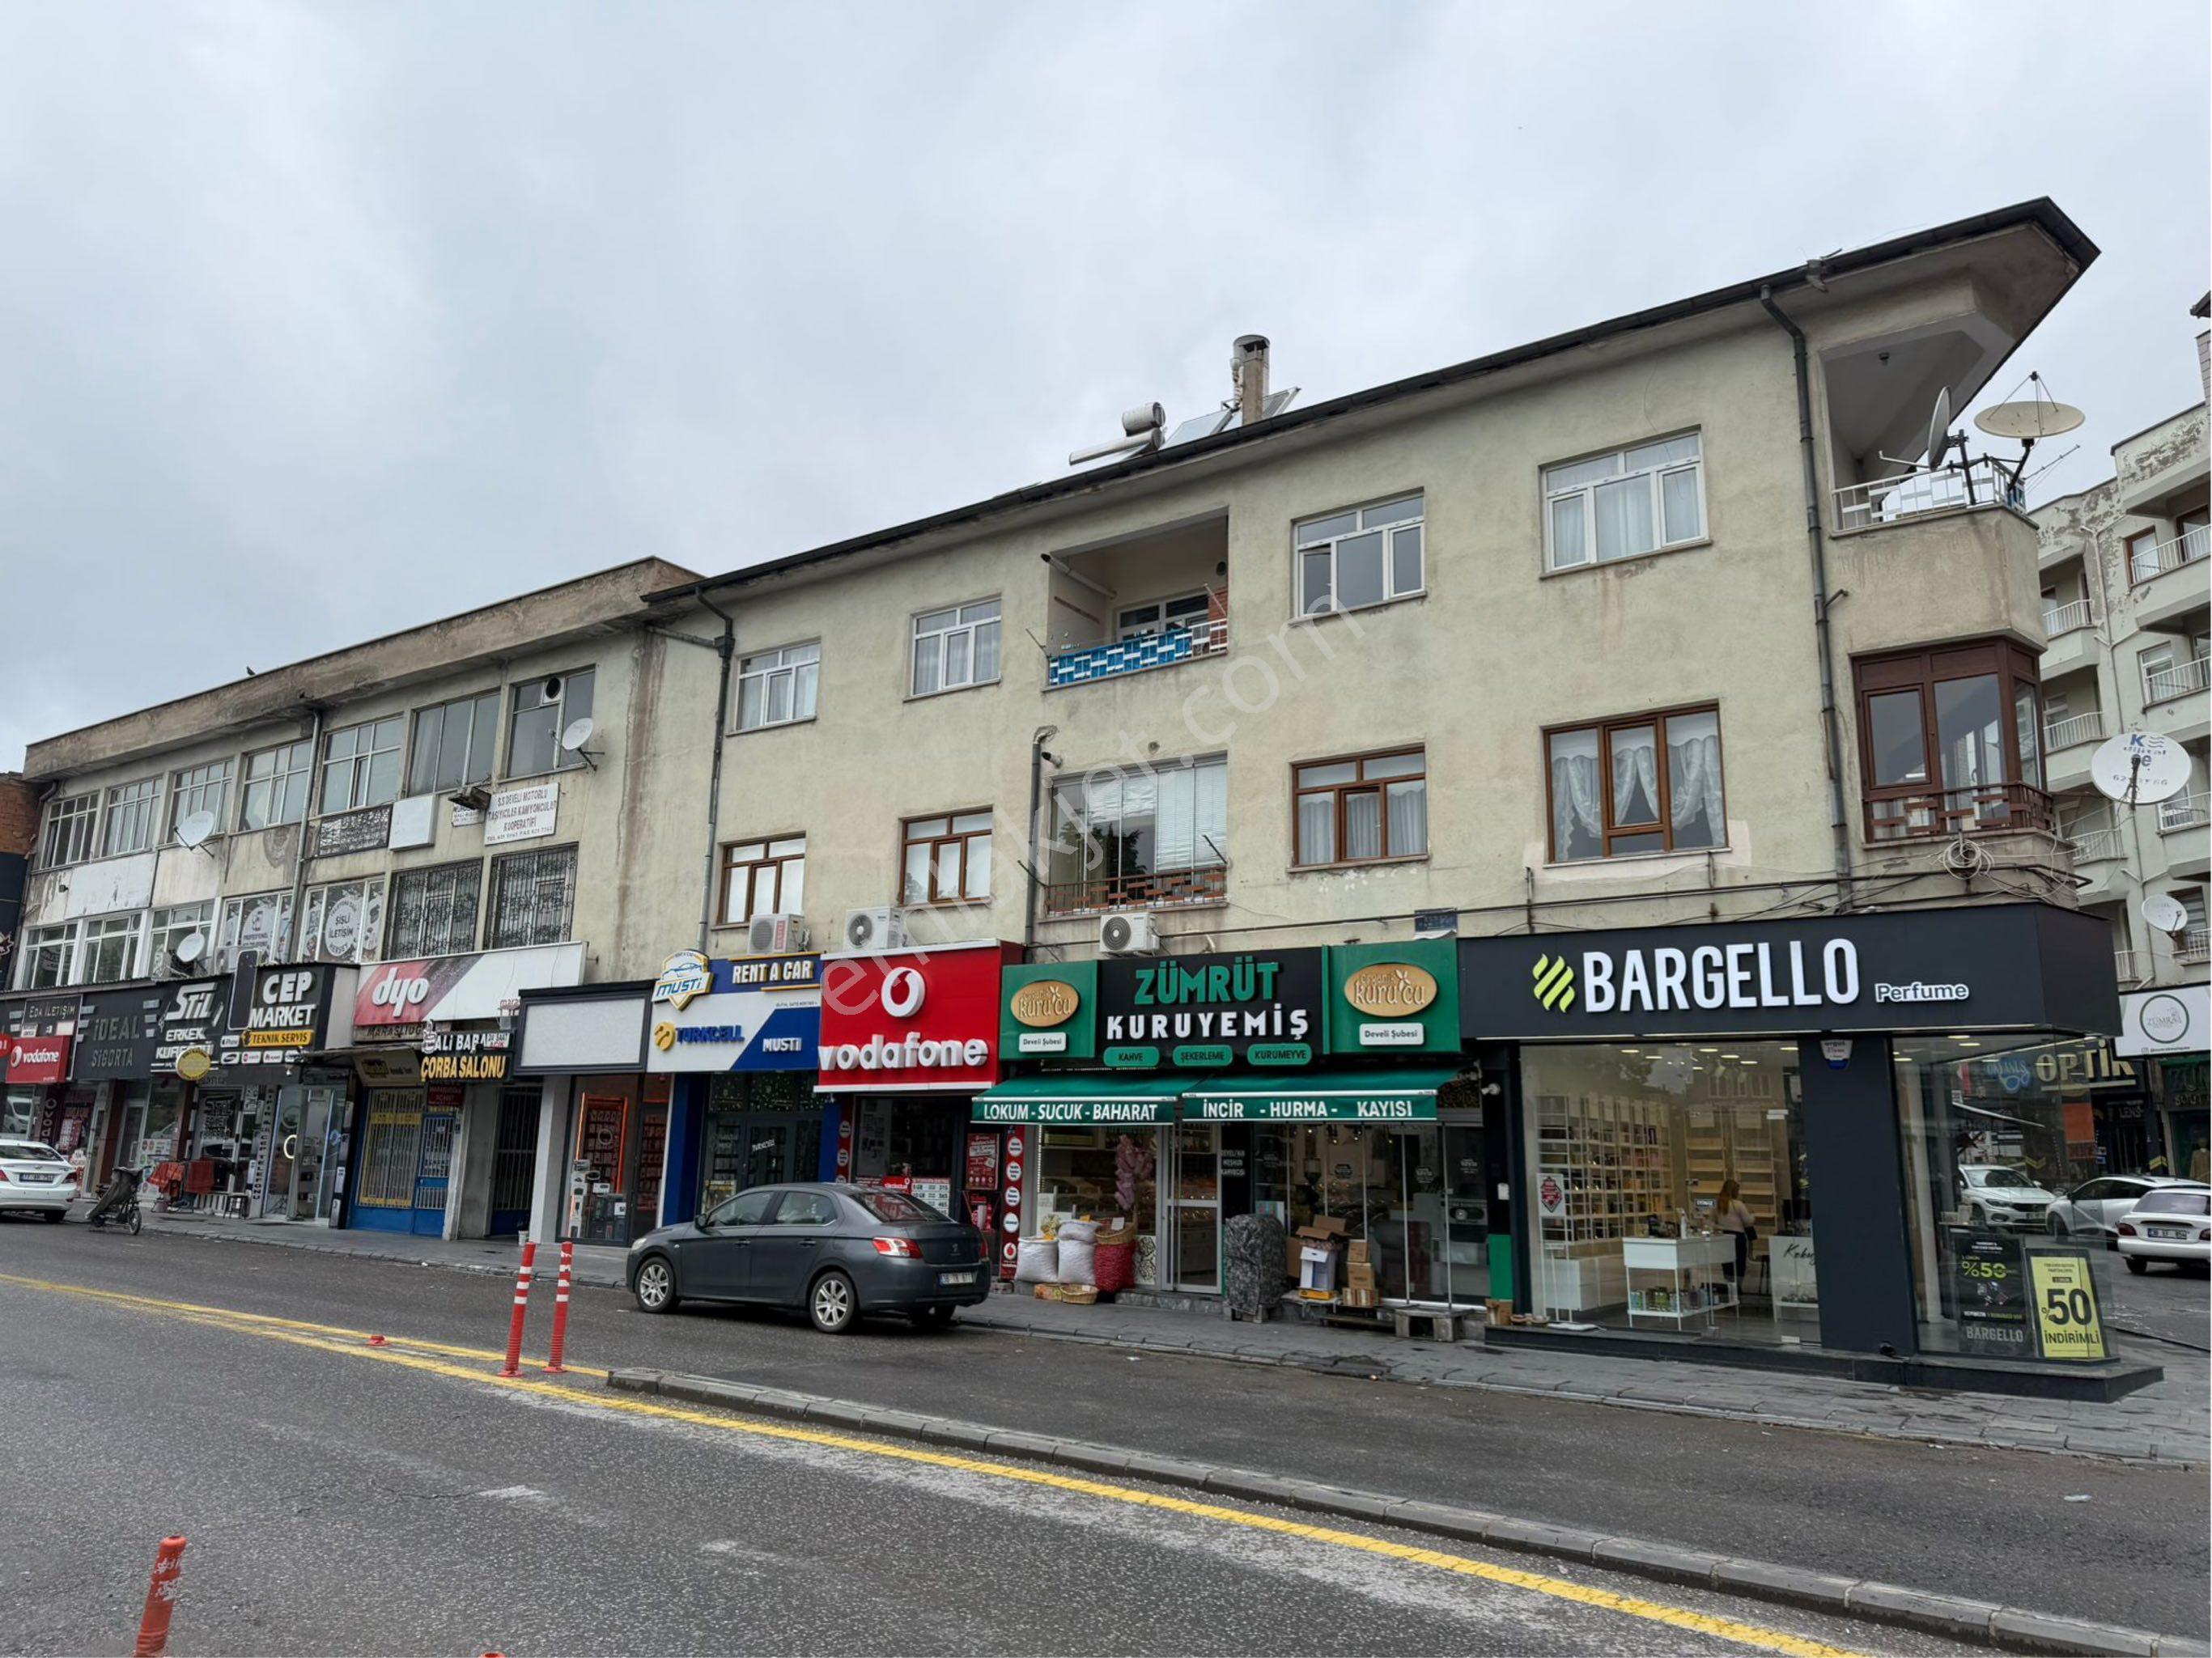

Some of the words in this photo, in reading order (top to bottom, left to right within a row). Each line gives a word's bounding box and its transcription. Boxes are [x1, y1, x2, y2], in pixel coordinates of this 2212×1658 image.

[732, 963, 766, 984] RENT
[769, 961, 782, 981] A
[783, 960, 813, 981] CAR
[1134, 955, 1280, 1006] ZÜMRÜT
[1583, 938, 1860, 1013] BARGELLO
[262, 971, 313, 1005] CEP
[371, 967, 431, 1018] dyo
[1874, 981, 1970, 1004] Perfume
[247, 1003, 316, 1028] MARKET
[1106, 1003, 1309, 1041] KURUYEMİŞ
[165, 1028, 207, 1041] ERKEK
[675, 1025, 746, 1045] TURKCELL
[1365, 1029, 1390, 1038] Develi
[1390, 1028, 1418, 1040] Şubesi
[23, 1048, 60, 1064] vodafone
[818, 1033, 989, 1071] vodafone
[1118, 1053, 1144, 1062] KAHVE
[1180, 1051, 1225, 1062] ŞEKERLEME
[1255, 1049, 1307, 1060] KURUMEYVE
[420, 1056, 456, 1083] ÇORBA
[460, 1054, 507, 1079] SALONU
[984, 1104, 1029, 1121] LOKUM
[1038, 1104, 1082, 1121] SUCUK
[1093, 1104, 1157, 1121] BAHARAT
[1203, 1098, 1244, 1118] İNCİR
[1270, 1100, 1327, 1117] HURMA
[1356, 1100, 1412, 1117] KAYISI
[1962, 1262, 2007, 1278] %50
[2041, 1288, 2093, 1325] %50
[1966, 1325, 2024, 1342] BARGELLO
[2044, 1329, 2100, 1344] İNDİRİMLİ
